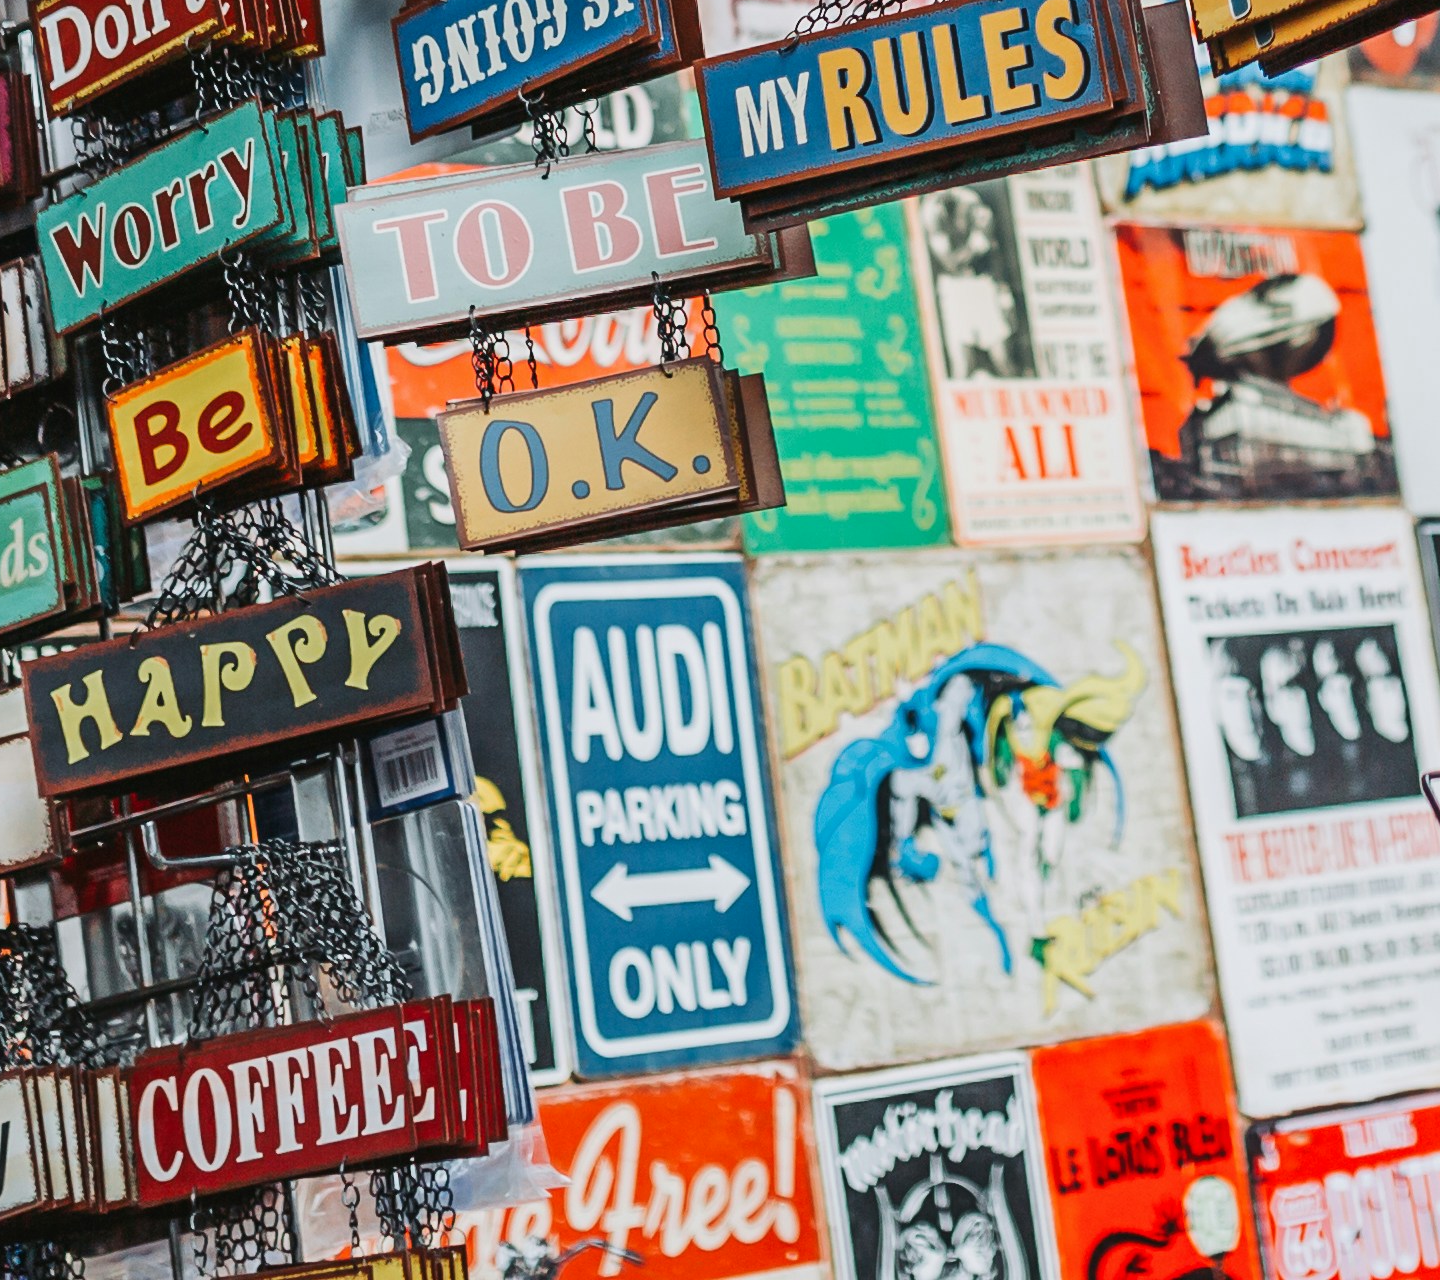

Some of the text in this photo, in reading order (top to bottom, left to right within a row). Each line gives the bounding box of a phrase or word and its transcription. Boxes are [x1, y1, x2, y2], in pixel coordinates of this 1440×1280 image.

[734, 71, 812, 159] MY
[50, 136, 260, 300] Worry
[372, 162, 720, 305] TO BE
[131, 390, 256, 489] Be
[478, 389, 712, 516] O.K.
[997, 425, 1082, 482] ALI
[1177, 536, 1404, 582] Beatles Concert
[49, 607, 404, 767] HAPPY
[570, 620, 734, 765] AUDI
[777, 568, 986, 760] BATMAN
[575, 778, 748, 848] PARKING
[607, 936, 752, 1021] ONLY
[137, 1026, 407, 1185] COFFEE
[564, 1086, 801, 1278] Free!
